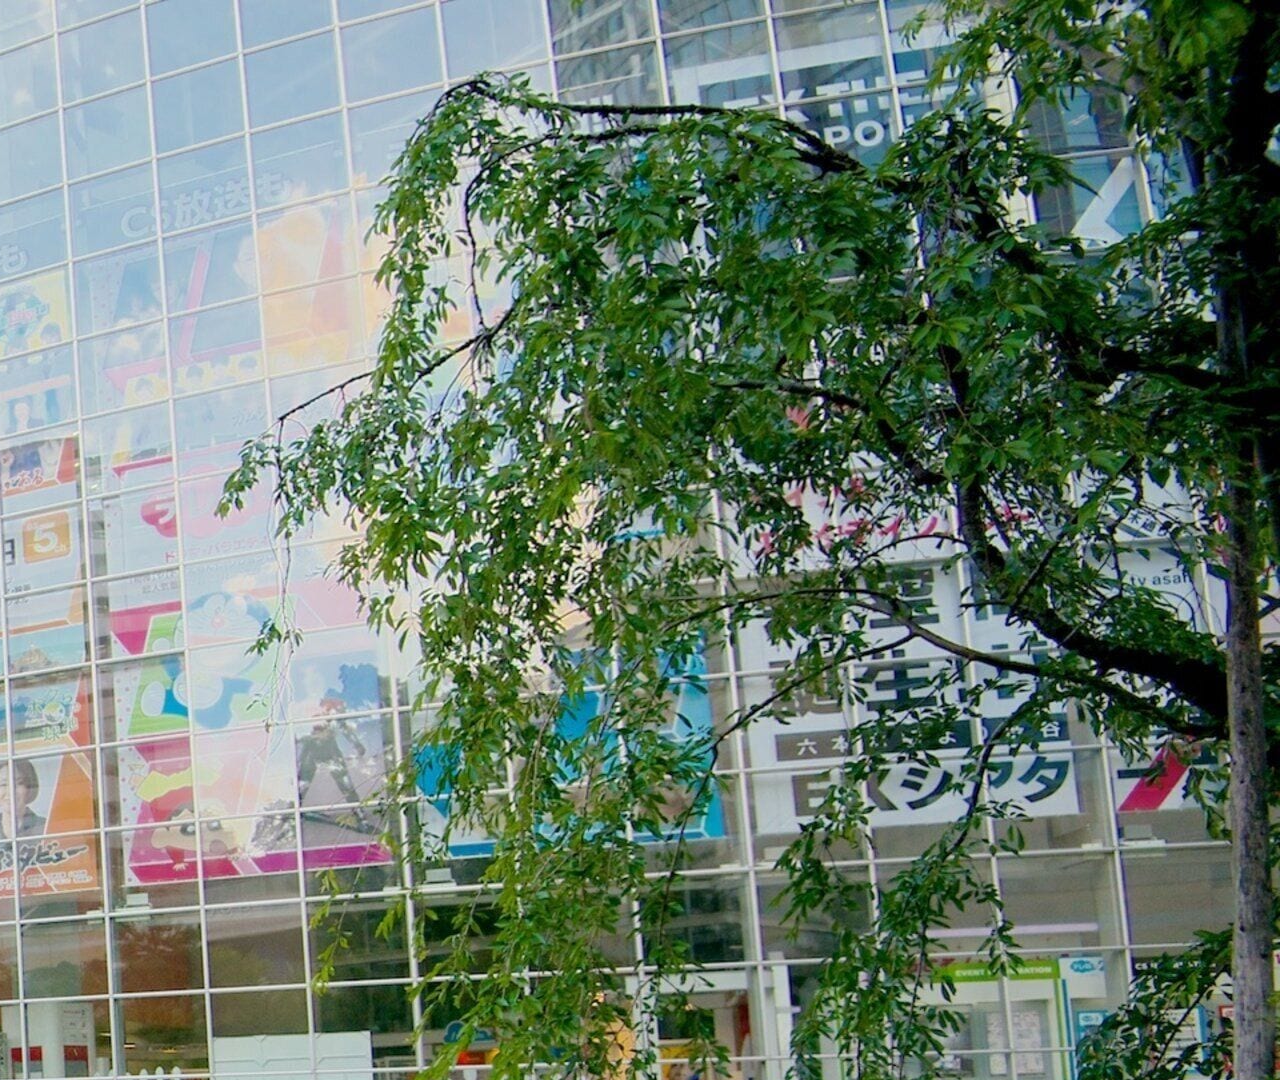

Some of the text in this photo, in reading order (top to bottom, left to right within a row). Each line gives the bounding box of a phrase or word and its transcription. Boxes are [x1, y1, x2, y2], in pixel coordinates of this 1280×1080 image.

[1130, 573, 1192, 586] tv asah
[954, 969, 985, 977] EVENT
